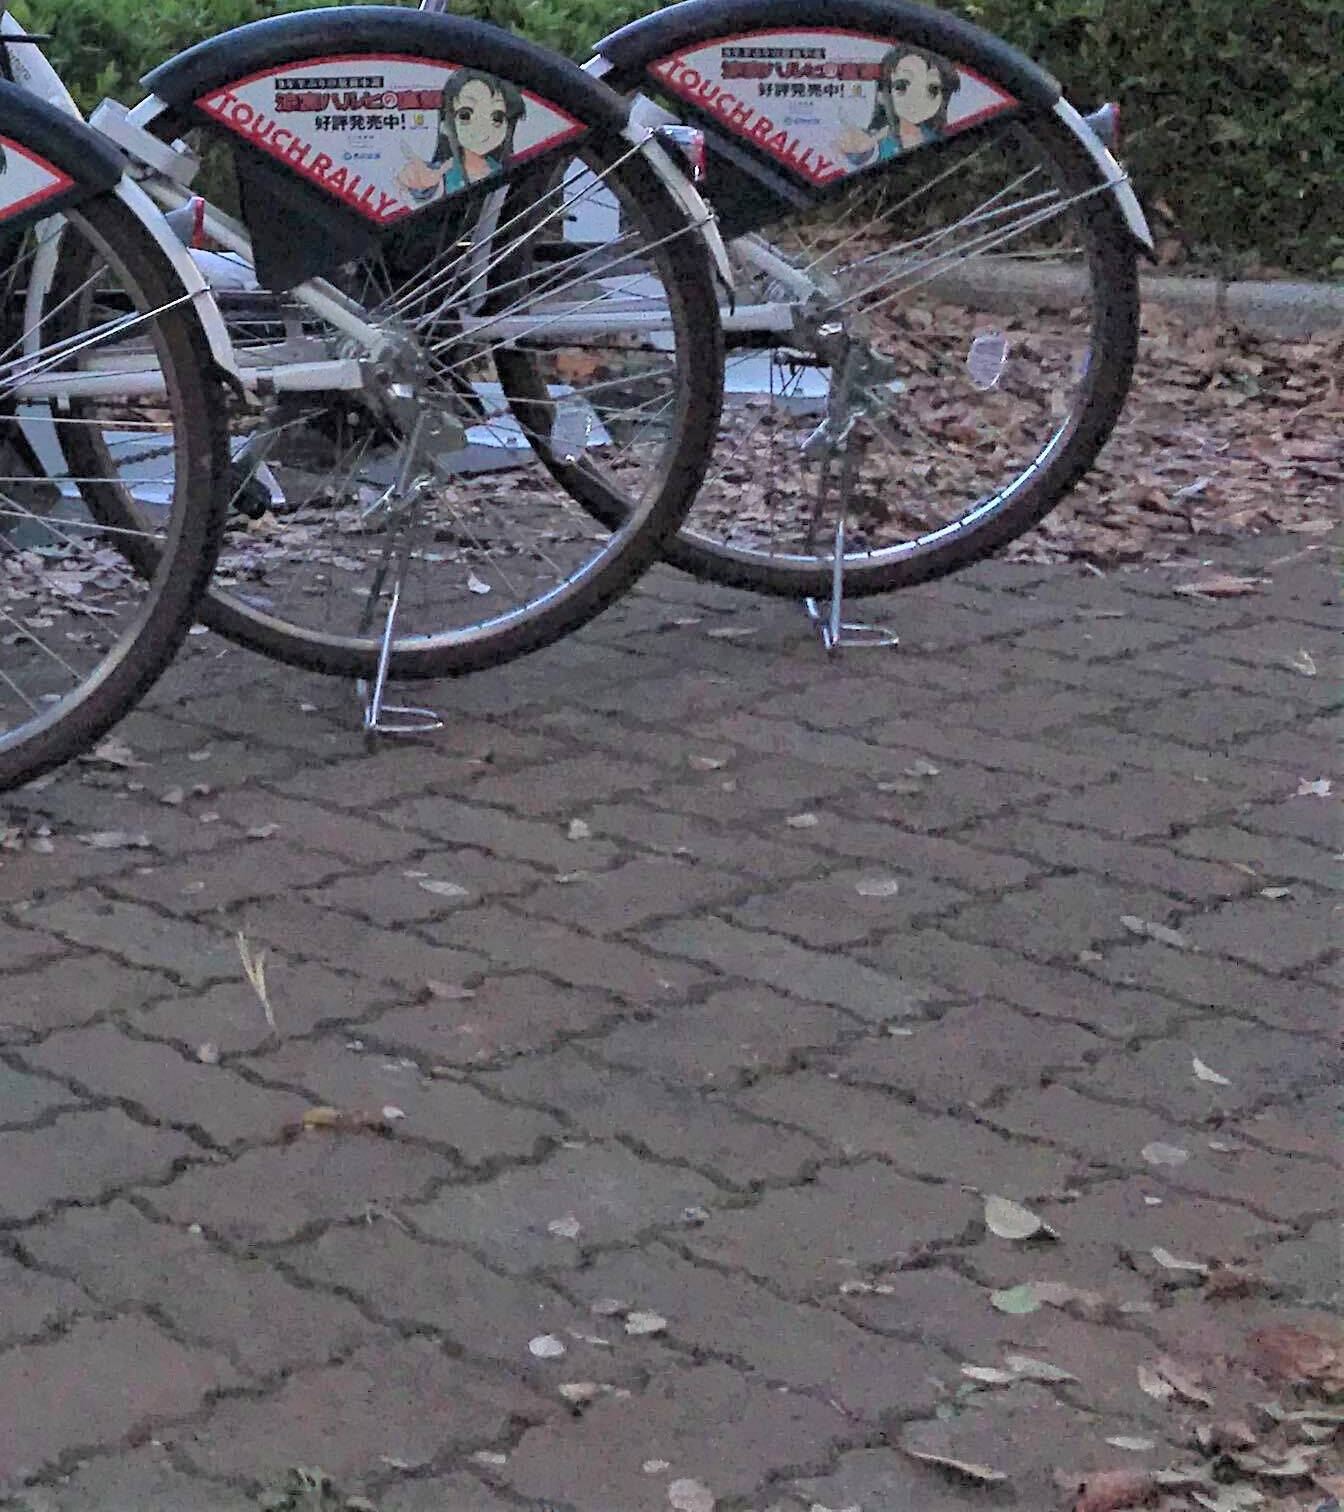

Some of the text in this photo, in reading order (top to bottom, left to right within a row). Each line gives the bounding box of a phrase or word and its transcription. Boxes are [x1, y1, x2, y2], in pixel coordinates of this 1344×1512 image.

[219, 88, 398, 218] TOUCH RALLY
[666, 58, 834, 179] TOUCH RALLY
